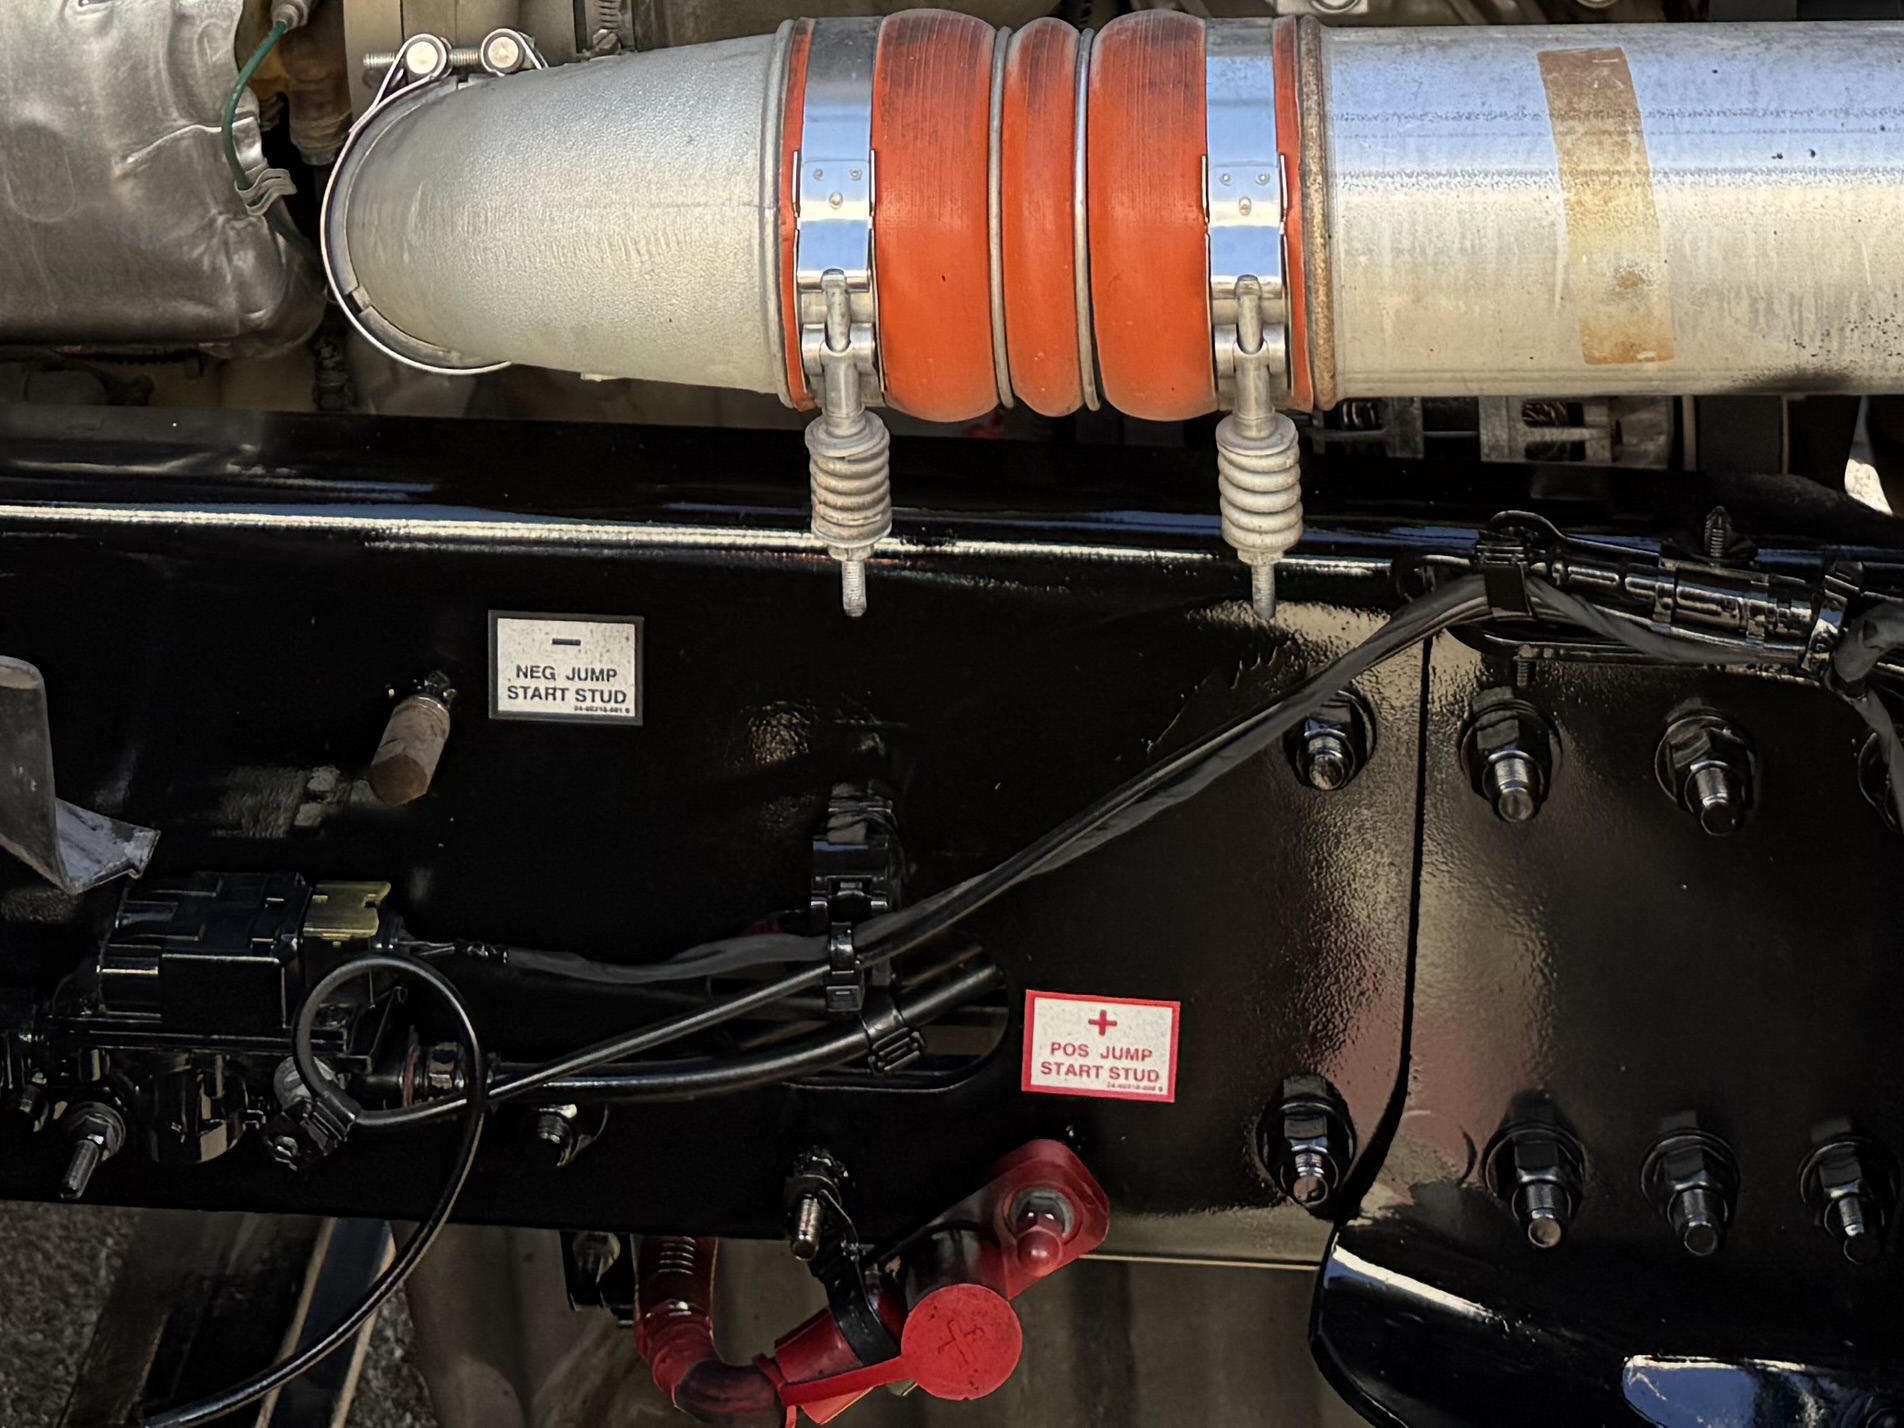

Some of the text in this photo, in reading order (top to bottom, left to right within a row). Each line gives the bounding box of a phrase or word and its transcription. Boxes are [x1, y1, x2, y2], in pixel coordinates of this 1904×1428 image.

[515, 664, 618, 682] NEG JUMP
[507, 685, 627, 704] START STUD
[1050, 1041, 1153, 1062] POS JUMP
[1040, 1061, 1160, 1083] START STUD
